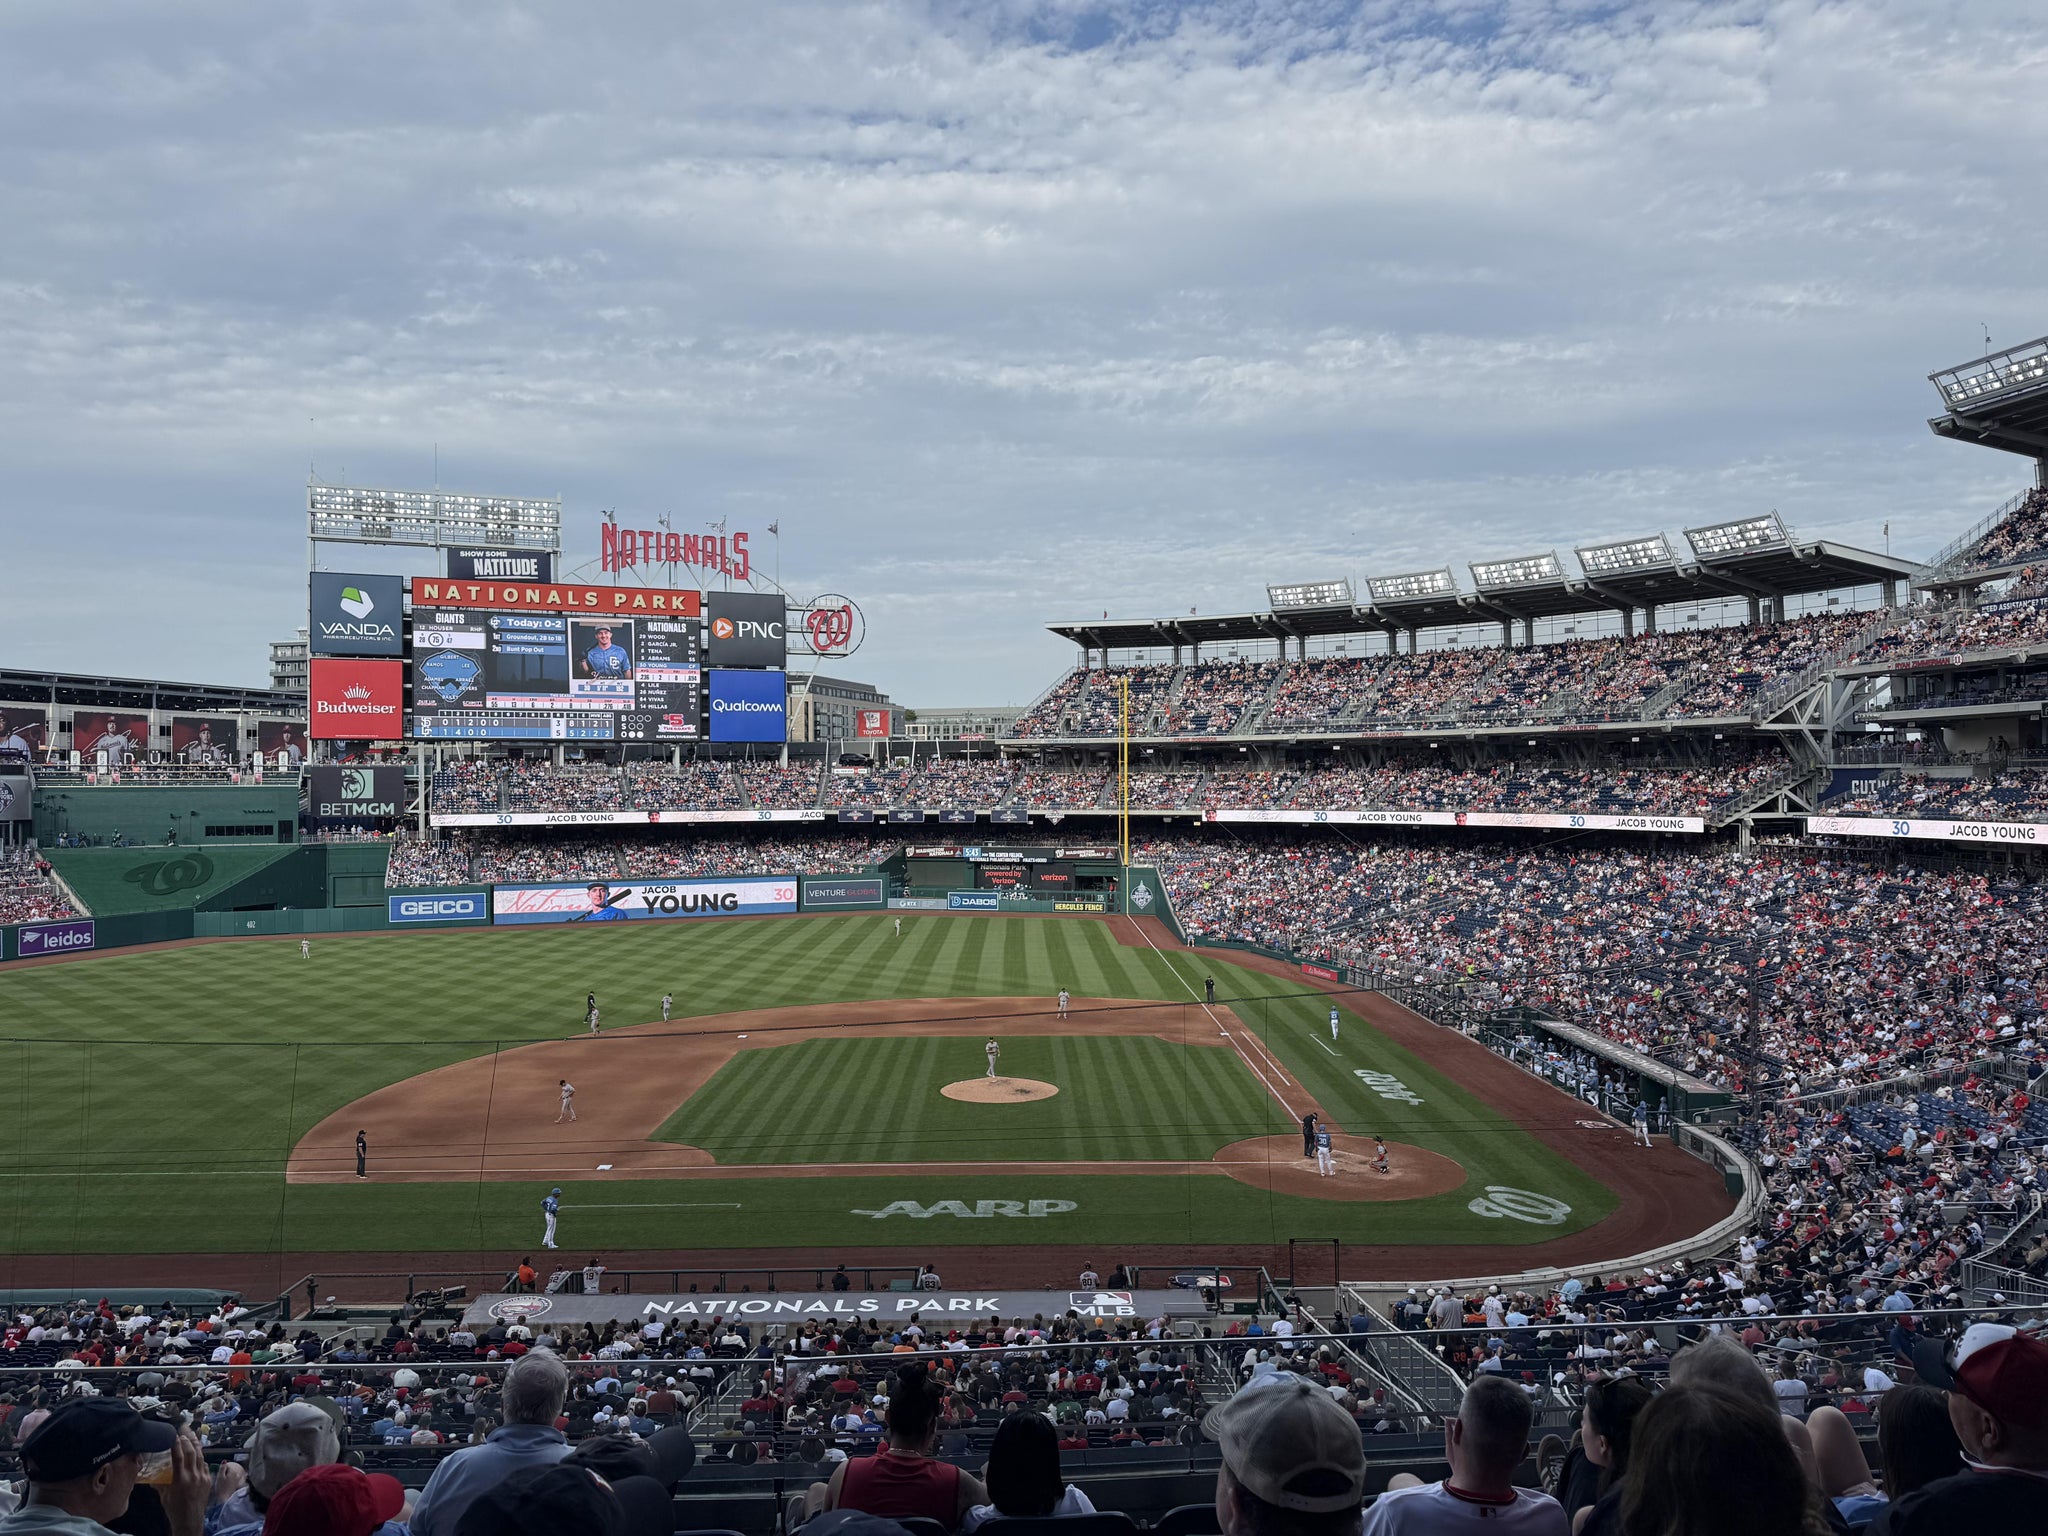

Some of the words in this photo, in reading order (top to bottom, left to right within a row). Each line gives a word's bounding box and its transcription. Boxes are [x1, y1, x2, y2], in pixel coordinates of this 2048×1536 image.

[602, 522, 748, 580] NATIONALS
[474, 558, 538, 576] NATITUDE
[424, 583, 598, 607] NATIONALS
[614, 593, 686, 610] PARK
[436, 613, 465, 624] GIANTS
[507, 618, 542, 628] Today:
[319, 622, 395, 636] VANDA
[647, 622, 686, 632] NATIONALS
[736, 620, 783, 639] PNC
[807, 605, 852, 650] W
[432, 636, 440, 644] 75
[317, 701, 396, 714] Budweiser
[712, 699, 783, 713] Qualcomm
[320, 803, 394, 816] BETMGM
[758, 811, 772, 820] 30
[497, 815, 513, 824] 30
[580, 814, 615, 822] YOUNG
[1314, 812, 1328, 822] 30
[1357, 813, 1387, 822] JACOB
[1390, 814, 1422, 822] YOUNG
[1569, 815, 1585, 827] 30
[1616, 818, 1647, 828] JACOB
[1650, 819, 1685, 829] YOUNG
[1892, 821, 1910, 836] 30
[1949, 824, 1988, 837] JACOB
[1992, 826, 2036, 840] YOUNG
[642, 886, 676, 894] JACOB
[774, 888, 794, 901] 30
[809, 889, 846, 897] VENTURE
[847, 888, 878, 896] GLOBAL
[400, 900, 474, 916] GEICO
[642, 893, 738, 914] YOUNG
[1055, 903, 1084, 911] HERCULES
[247, 920, 256, 929] 402
[44, 930, 91, 948] leidos
[850, 1199, 1078, 1218] AARP
[585, 1272, 595, 1280] 19
[643, 1298, 879, 1314] NATIONALS
[895, 1298, 999, 1311] PARK
[1071, 1306, 1136, 1316] MLB
